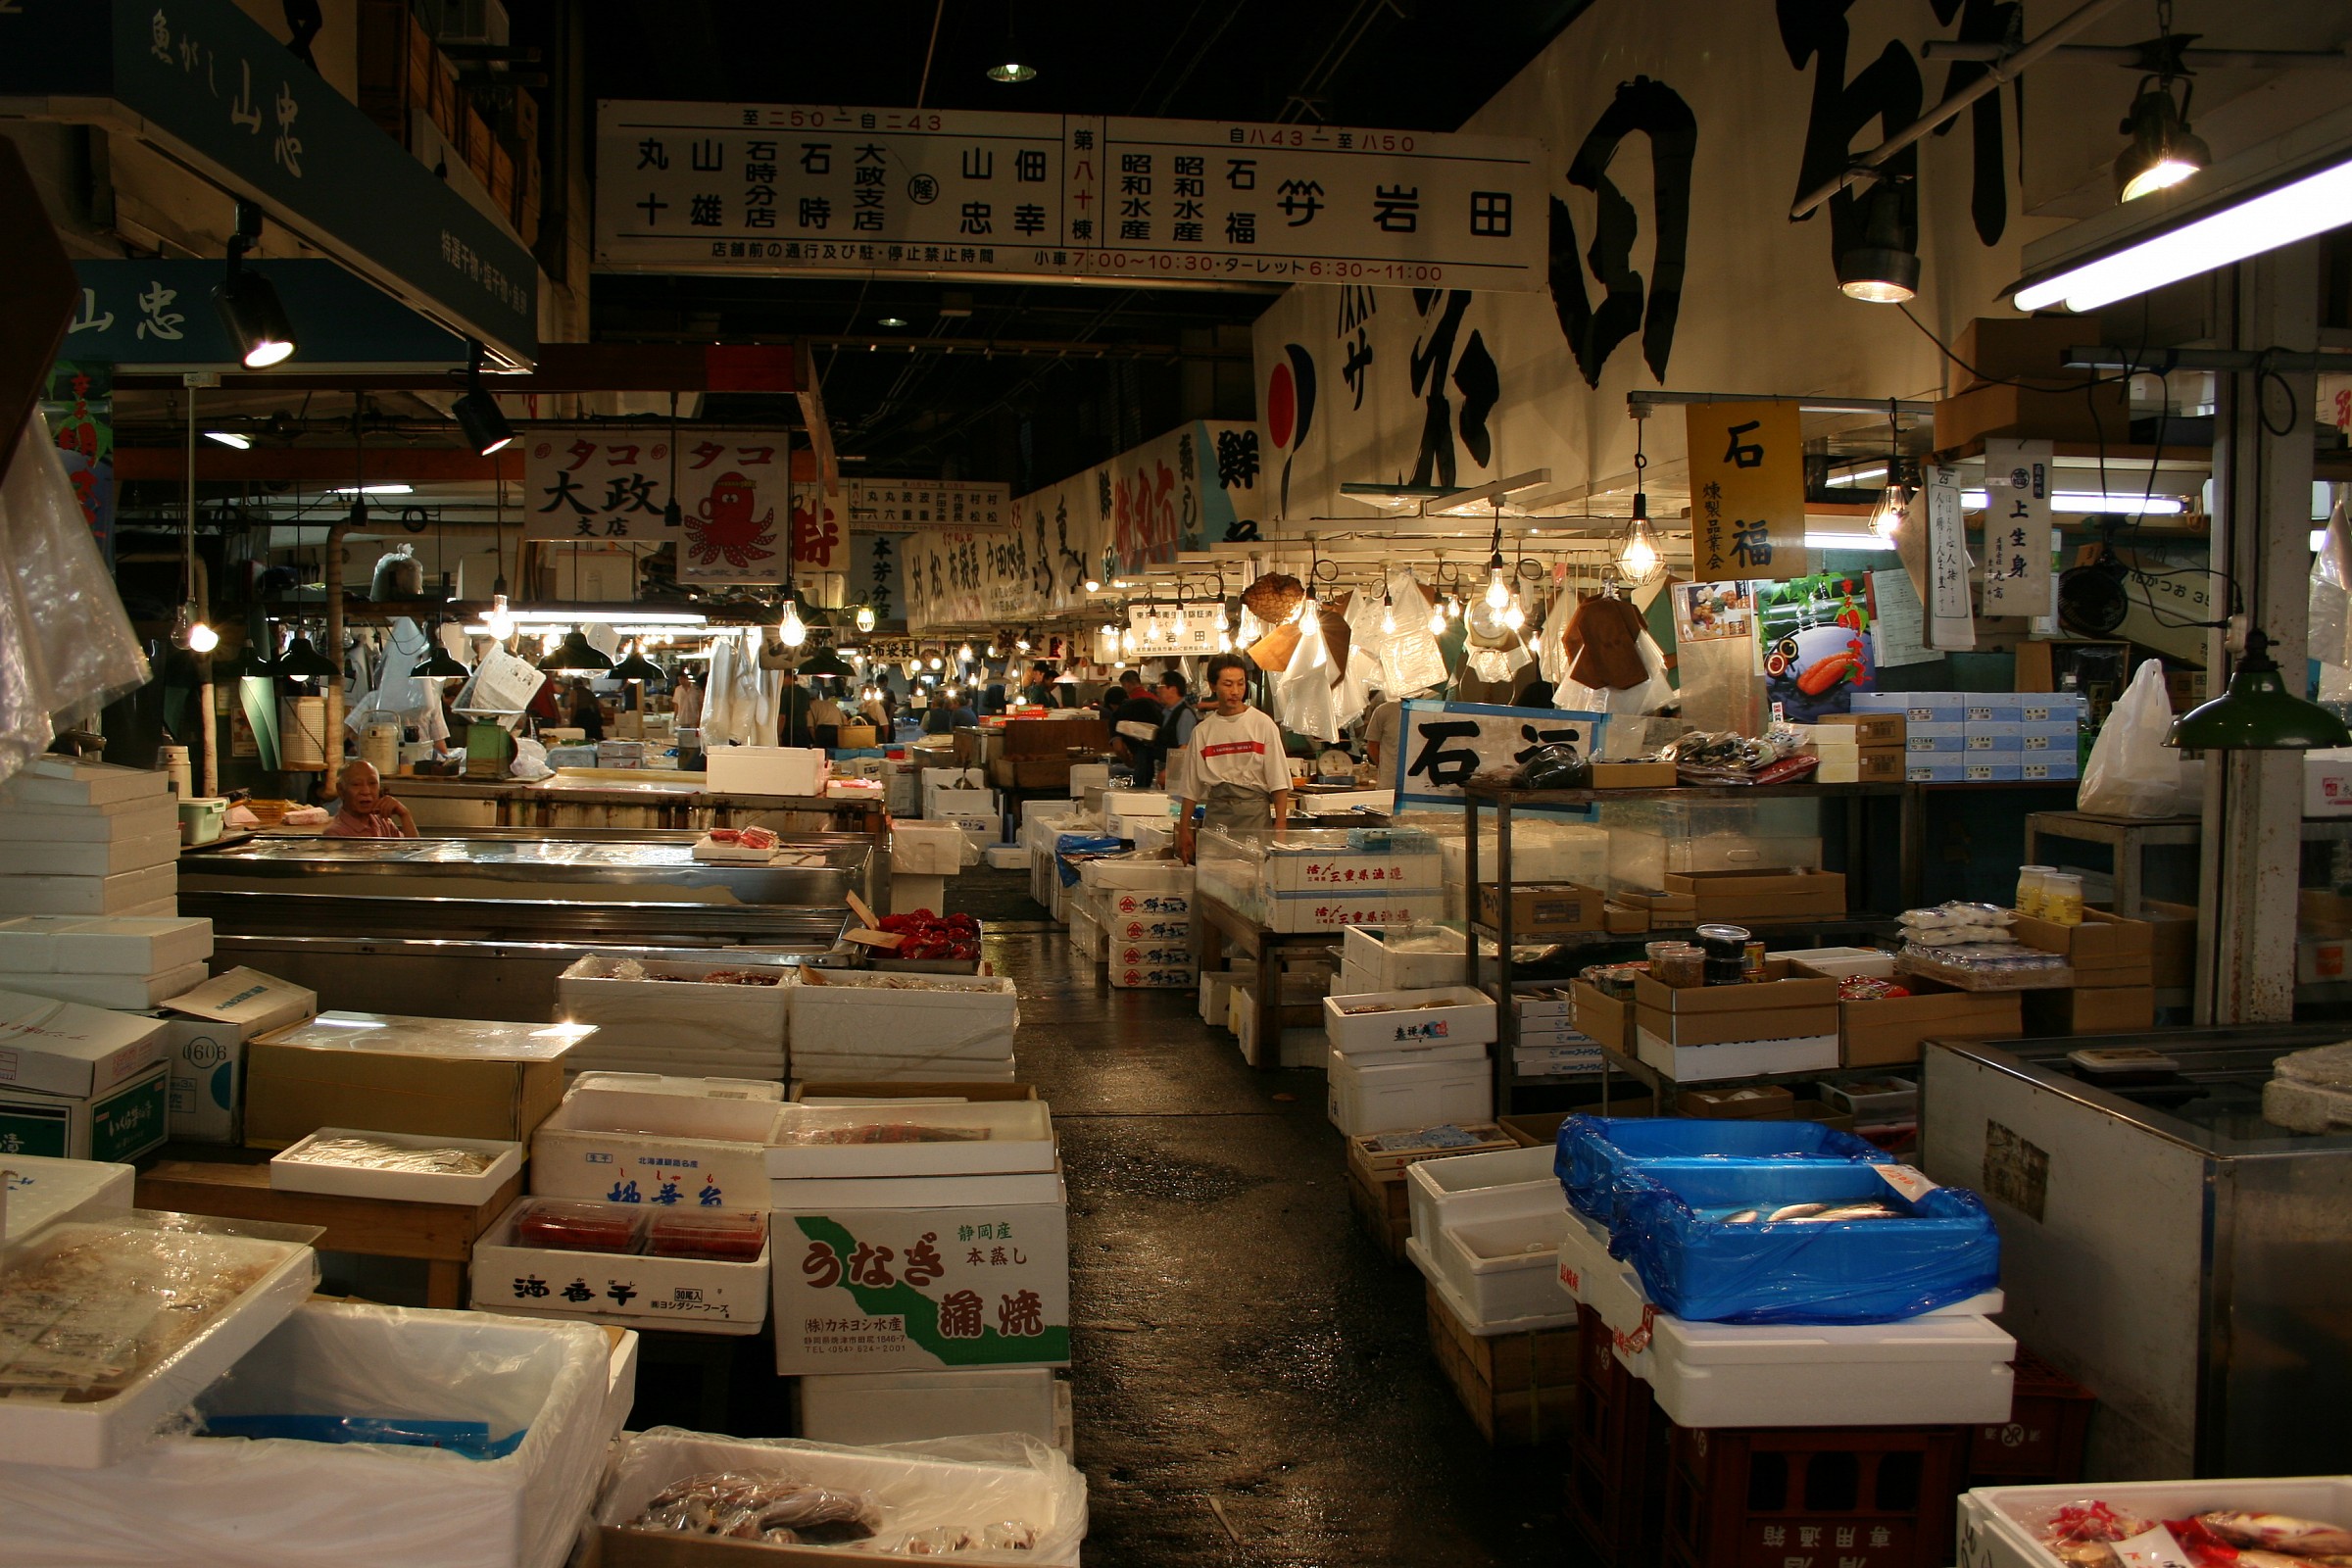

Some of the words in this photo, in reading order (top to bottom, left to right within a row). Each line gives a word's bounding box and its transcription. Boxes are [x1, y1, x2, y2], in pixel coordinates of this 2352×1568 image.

[151, 8, 220, 99] 魚がし
[230, 57, 303, 178] 山忠
[637, 138, 668, 225] 丸十
[691, 139, 723, 227] 山雄
[745, 141, 778, 228] 石時分店
[799, 143, 831, 230] 石時
[853, 143, 886, 231] 大政支店
[959, 147, 993, 235] 山忠
[1014, 149, 1047, 237] 佃幸
[1071, 128, 1094, 241] 第八十棟
[1119, 154, 1152, 240] 昭和水産
[1173, 156, 1204, 242] 昭和水産
[1225, 160, 1257, 245] 石福
[1372, 184, 1512, 237] 岩田
[68, 280, 186, 341] 山忠
[565, 439, 640, 471] タコ
[689, 440, 775, 469] タコ
[538, 470, 665, 515] 大政
[885, 491, 896, 520] 丸六
[970, 494, 981, 522] 村松
[987, 494, 998, 522] 村松
[1723, 420, 1773, 568] 石福
[574, 516, 629, 538] 支店
[2008, 500, 2030, 578] 上生身
[874, 643, 913, 659] 布袋長
[1330, 867, 1404, 882] 三重県漁連
[1339, 909, 1411, 924] 三重県漁連
[182, 1044, 227, 1060] 0606
[957, 1222, 1013, 1242] 静岡産
[966, 1247, 1028, 1267] 本蒸し
[802, 1232, 945, 1288] うなぎ
[675, 1289, 702, 1300] 30尾入
[940, 1290, 1045, 1337] 蒲焼
[1763, 1525, 1892, 1548] 専用通箱
